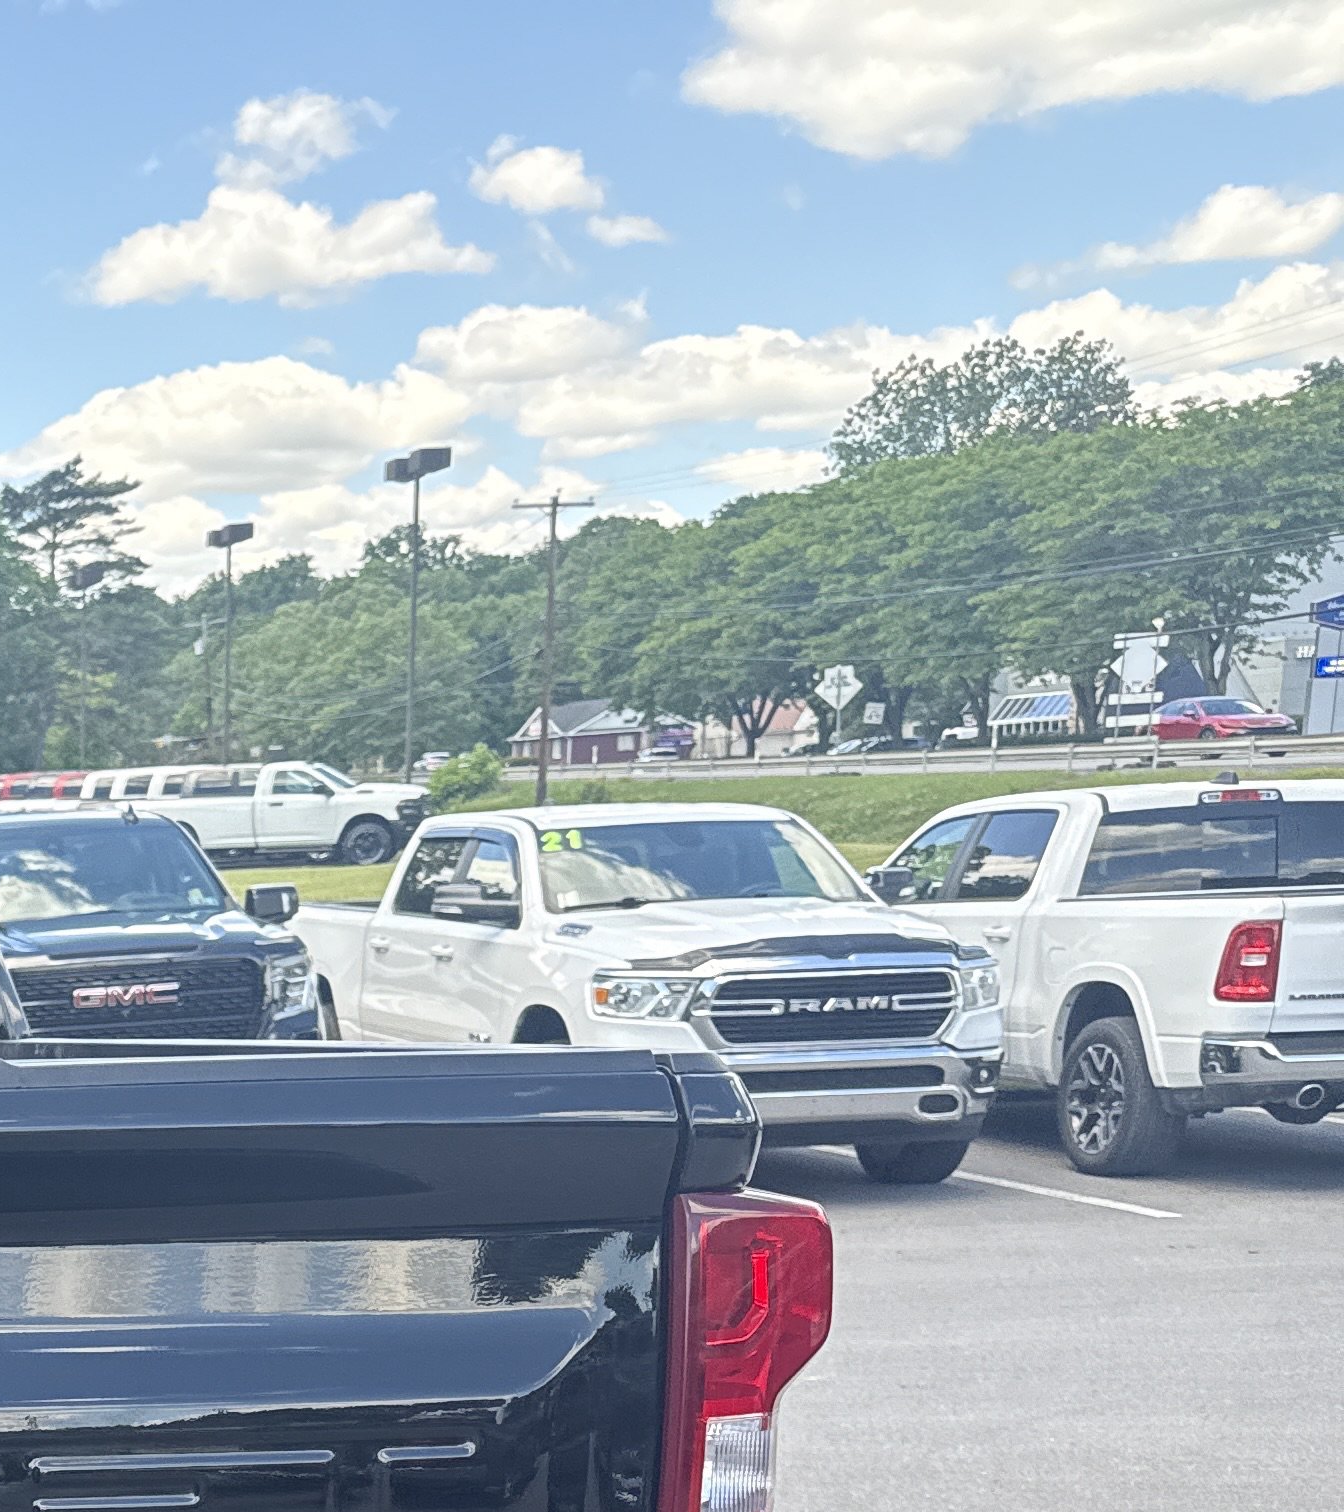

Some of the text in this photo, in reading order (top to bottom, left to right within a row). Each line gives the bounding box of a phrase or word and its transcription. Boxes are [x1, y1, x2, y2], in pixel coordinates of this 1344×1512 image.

[540, 829, 582, 852] 21
[73, 981, 180, 1009] GMC
[788, 995, 889, 1013] RAM
